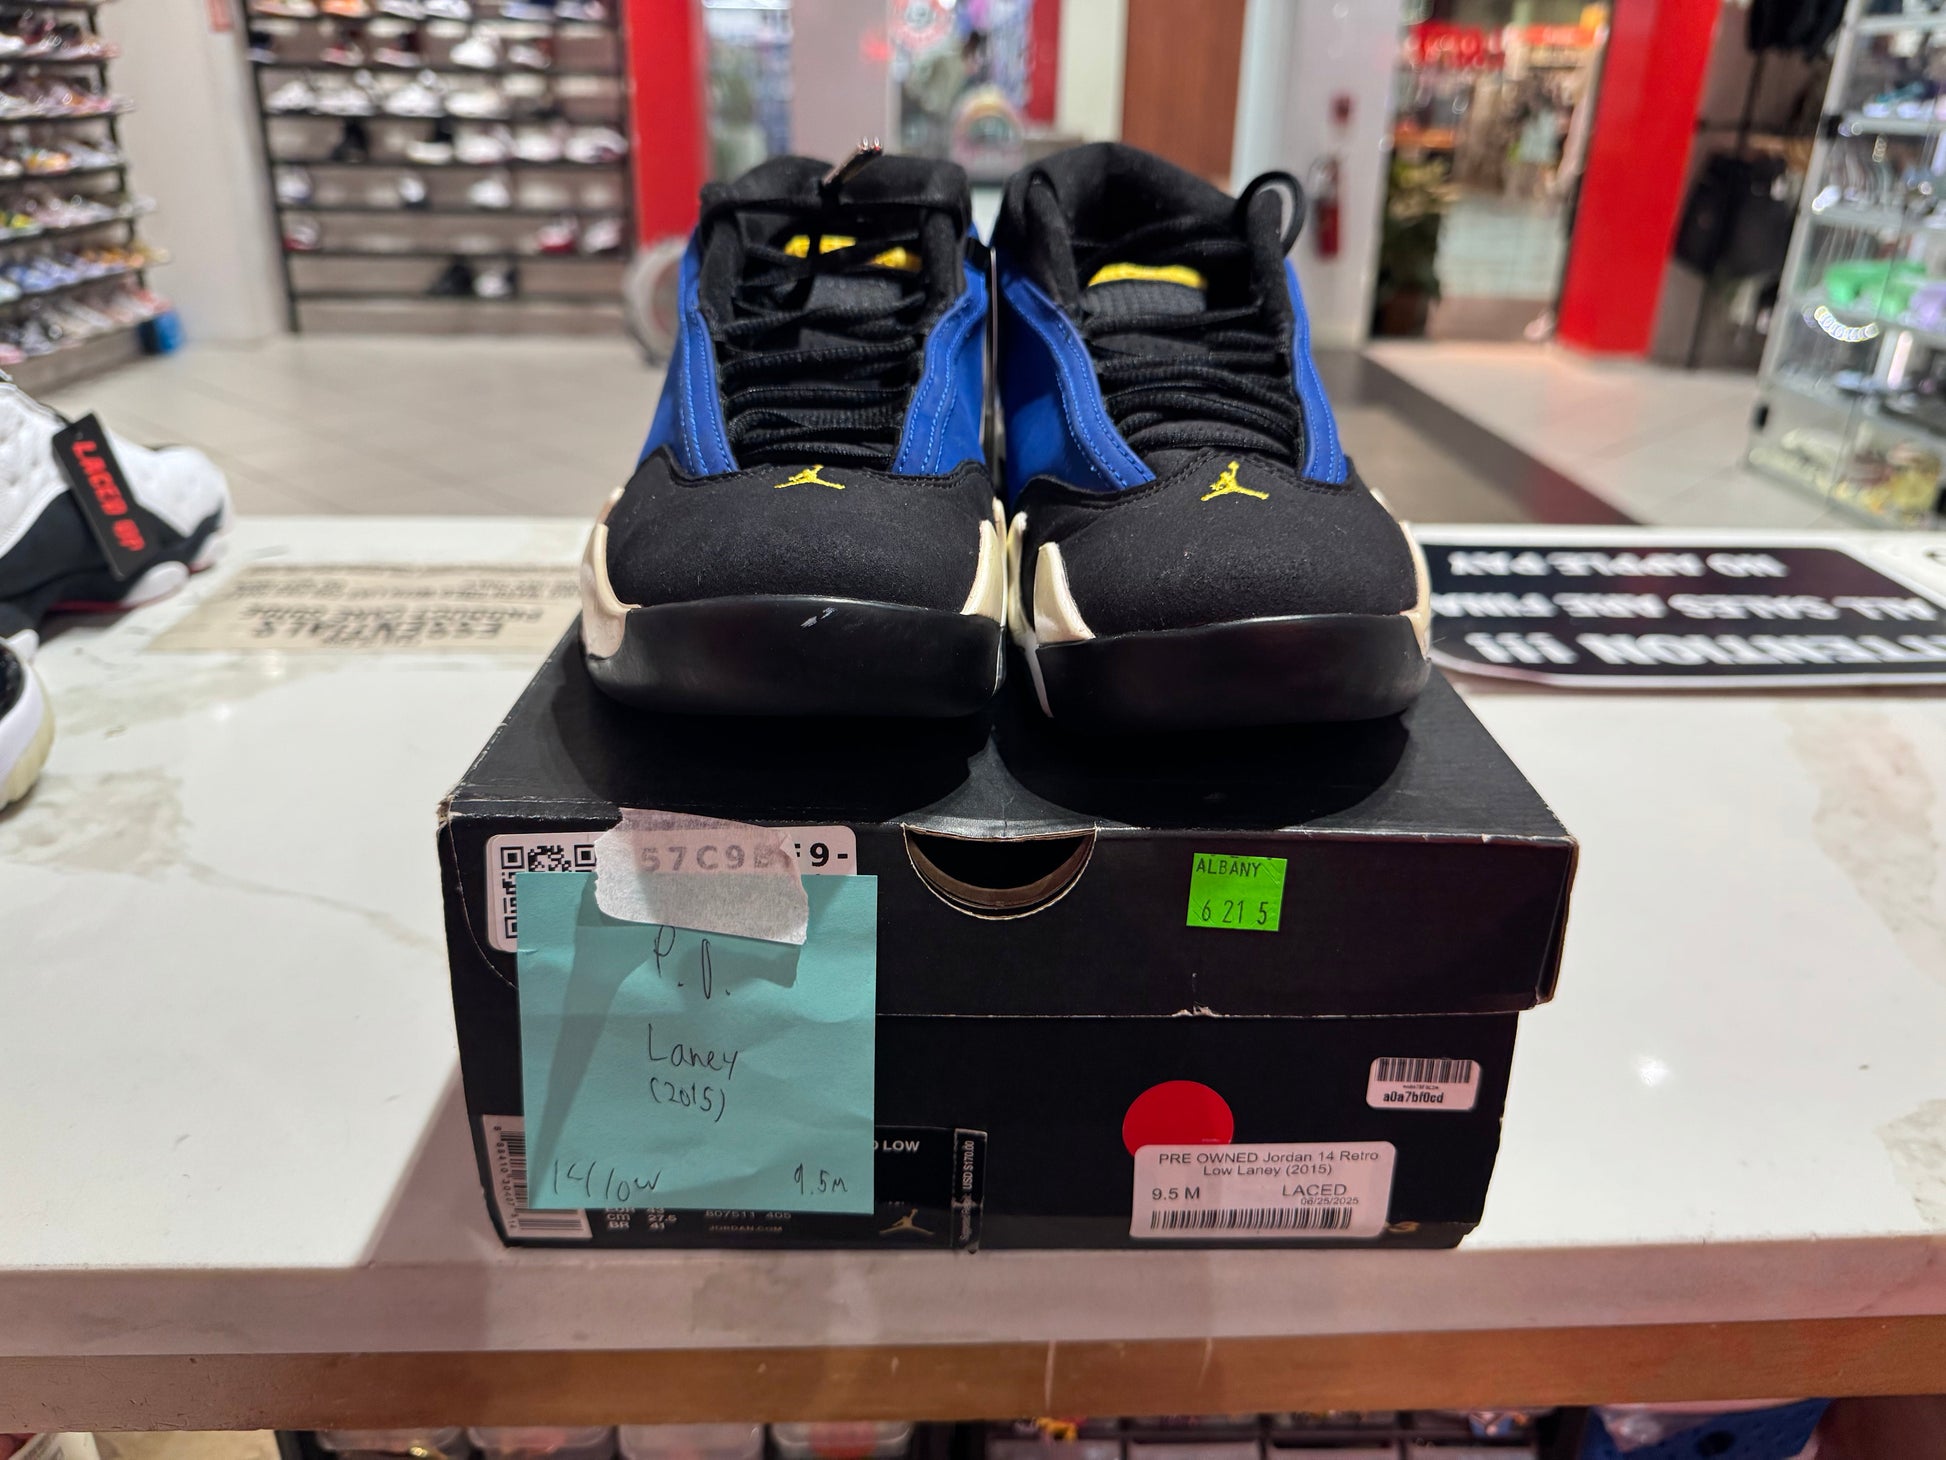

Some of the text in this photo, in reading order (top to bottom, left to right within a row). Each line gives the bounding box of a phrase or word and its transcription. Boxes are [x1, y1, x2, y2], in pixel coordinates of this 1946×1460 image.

[72, 441, 145, 550] LACED UP
[1449, 551, 1789, 577] NO APPLE PAY
[1432, 592, 1558, 618] FINA
[1552, 593, 1668, 619] ARE
[1668, 595, 1840, 620] SALES
[1196, 858, 1261, 877] ALBANY
[1201, 899, 1269, 925] 6 21 5
[648, 1023, 740, 1080] Laney
[650, 1076, 727, 1123] (2015)
[1383, 1091, 1445, 1104] a0a7bf0cd
[882, 1139, 921, 1152] LOW
[1158, 1150, 1380, 1165] PRE OWNED Jordan 14 Retro
[962, 1171, 974, 1190] USD
[1203, 1164, 1333, 1178] Low Laney (2015)
[1151, 1183, 1348, 1201] 9.5 M LACED
[608, 1221, 666, 1230] BR 41
